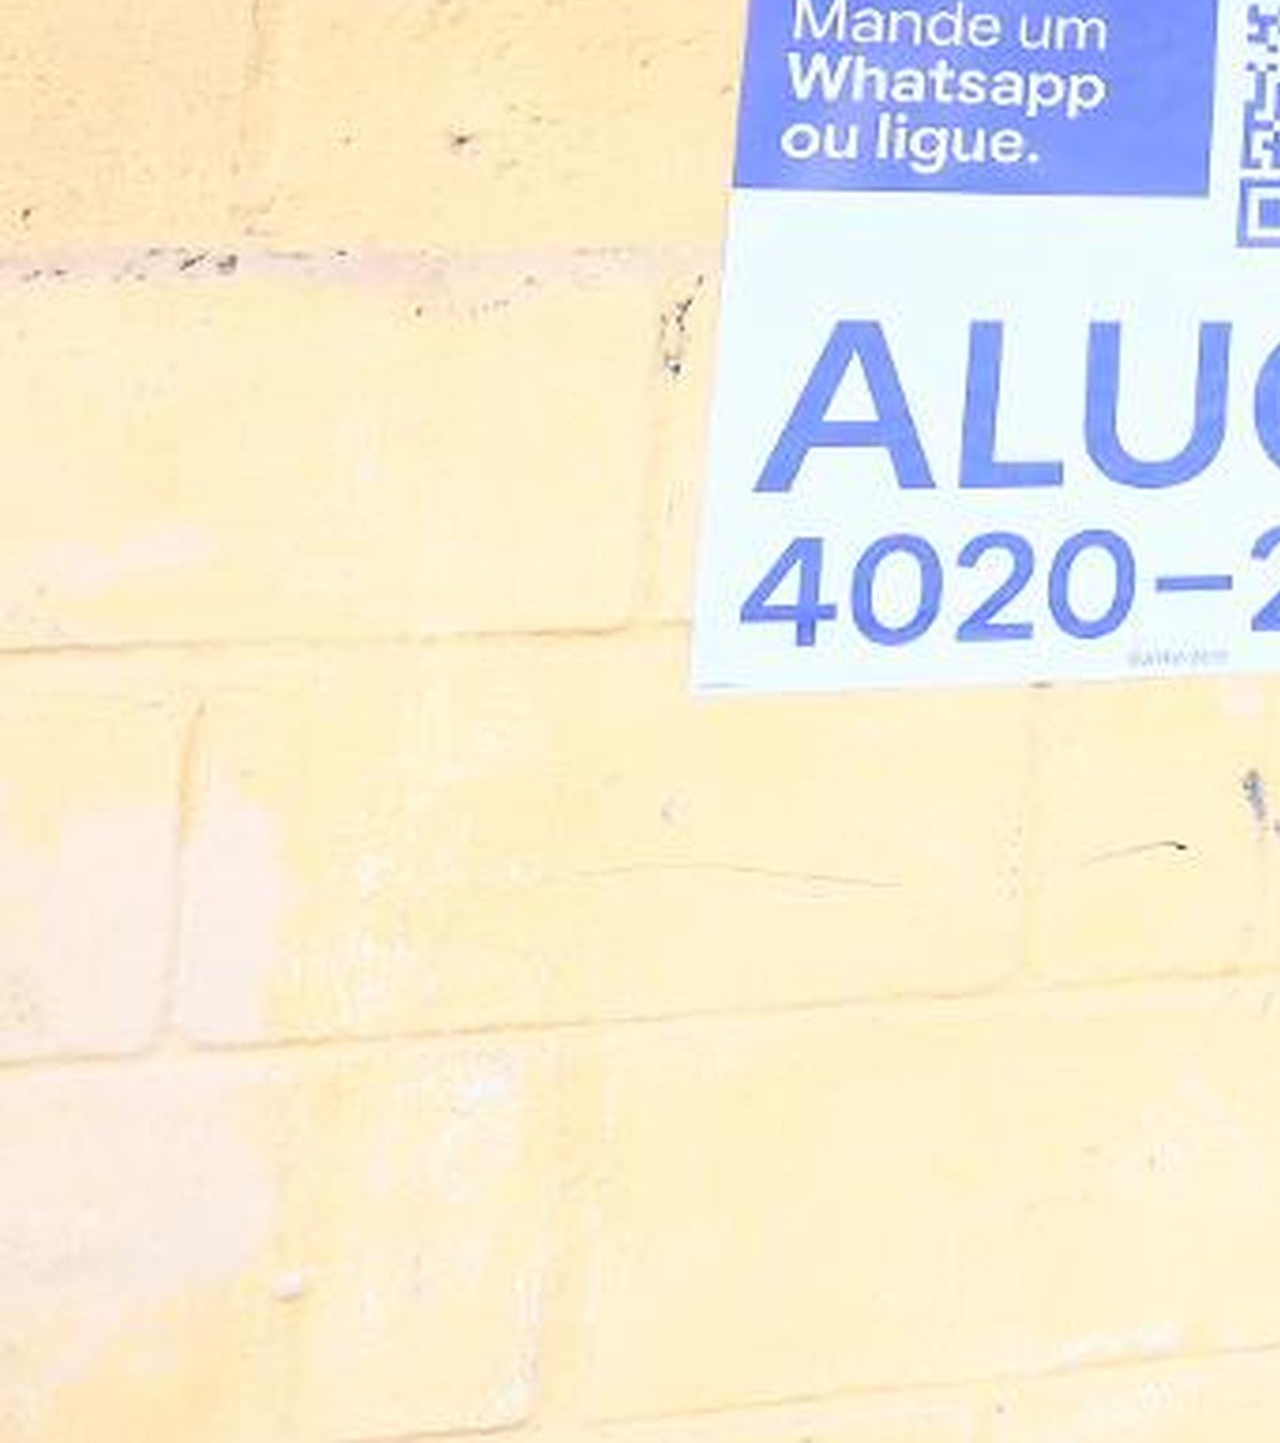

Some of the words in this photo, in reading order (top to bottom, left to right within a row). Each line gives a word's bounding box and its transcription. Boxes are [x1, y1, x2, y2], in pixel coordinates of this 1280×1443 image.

[1017, 10, 1107, 51] um
[784, 53, 1107, 120] Whatsapp
[780, 121, 860, 159] ou
[876, 111, 1041, 175] ligue.
